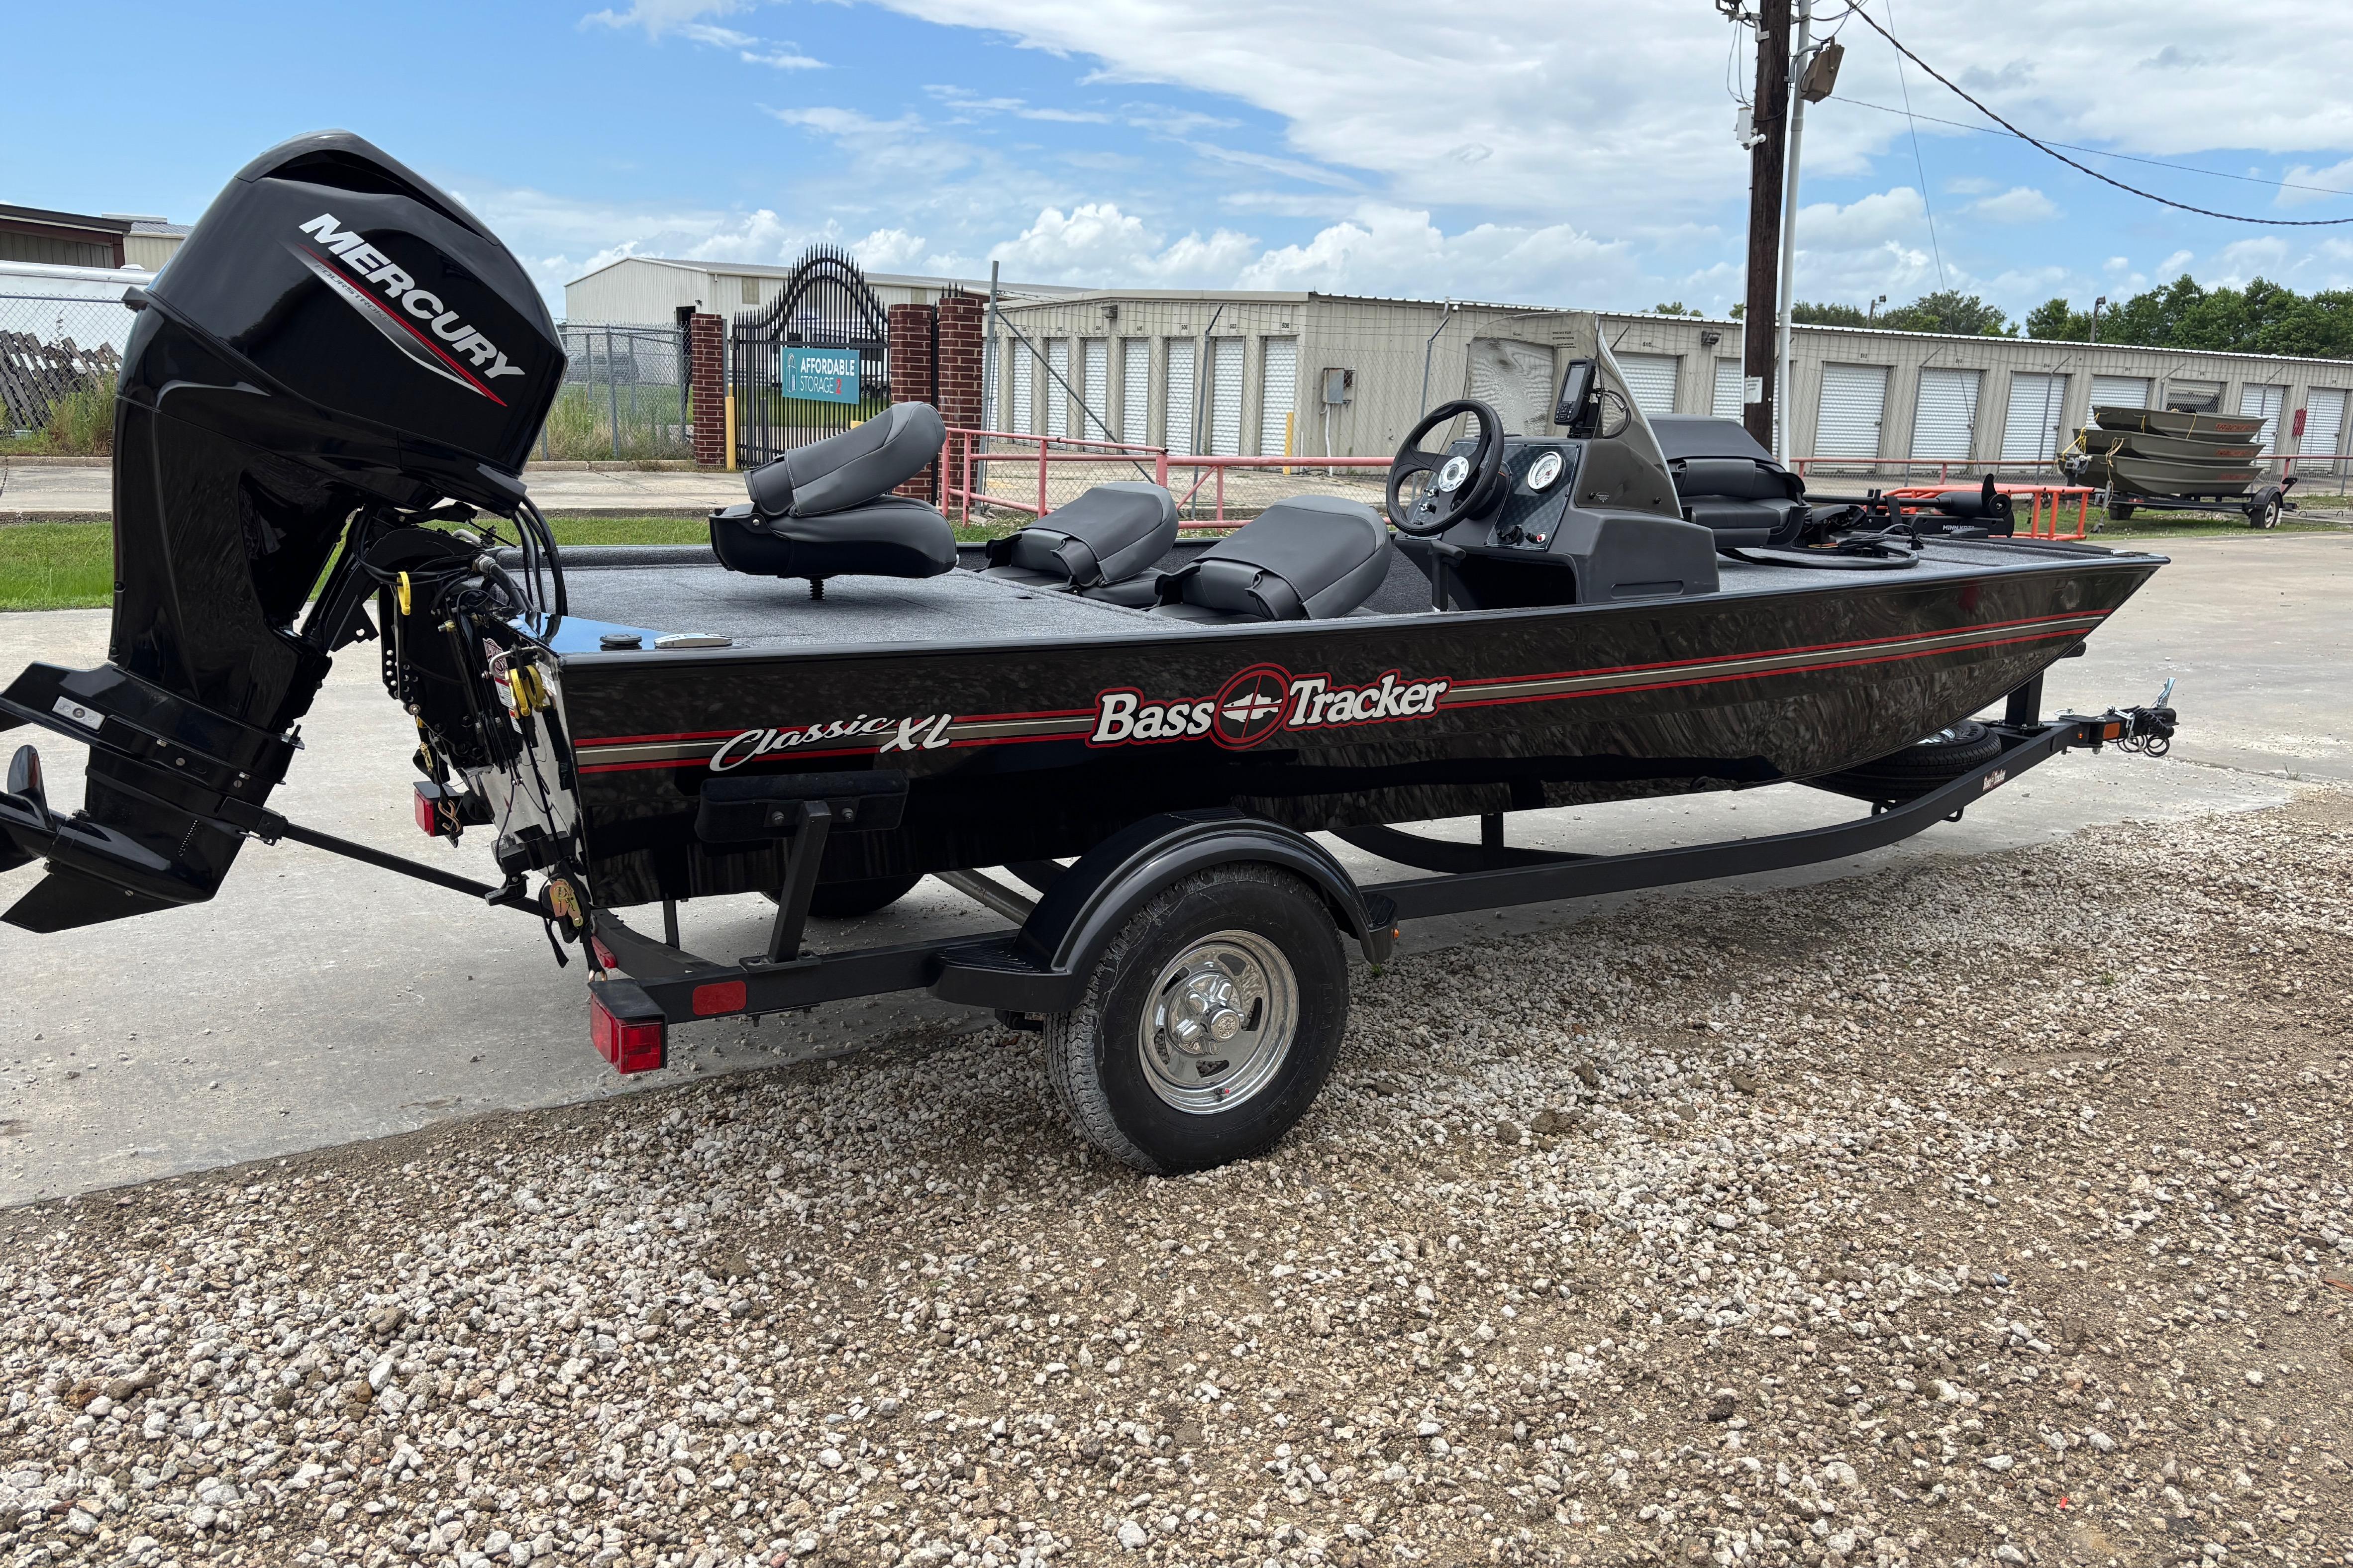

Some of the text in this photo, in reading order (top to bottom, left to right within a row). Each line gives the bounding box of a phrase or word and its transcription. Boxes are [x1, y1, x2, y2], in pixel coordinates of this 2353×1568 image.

[299, 213, 525, 379] MERCURY
[314, 263, 392, 323] FOURSTROKE
[800, 357, 855, 376] AFFORDABLE
[800, 375, 842, 395] STORAGE 2
[1092, 674, 1447, 742] Bass Tracker
[710, 713, 952, 772] Classic XL
